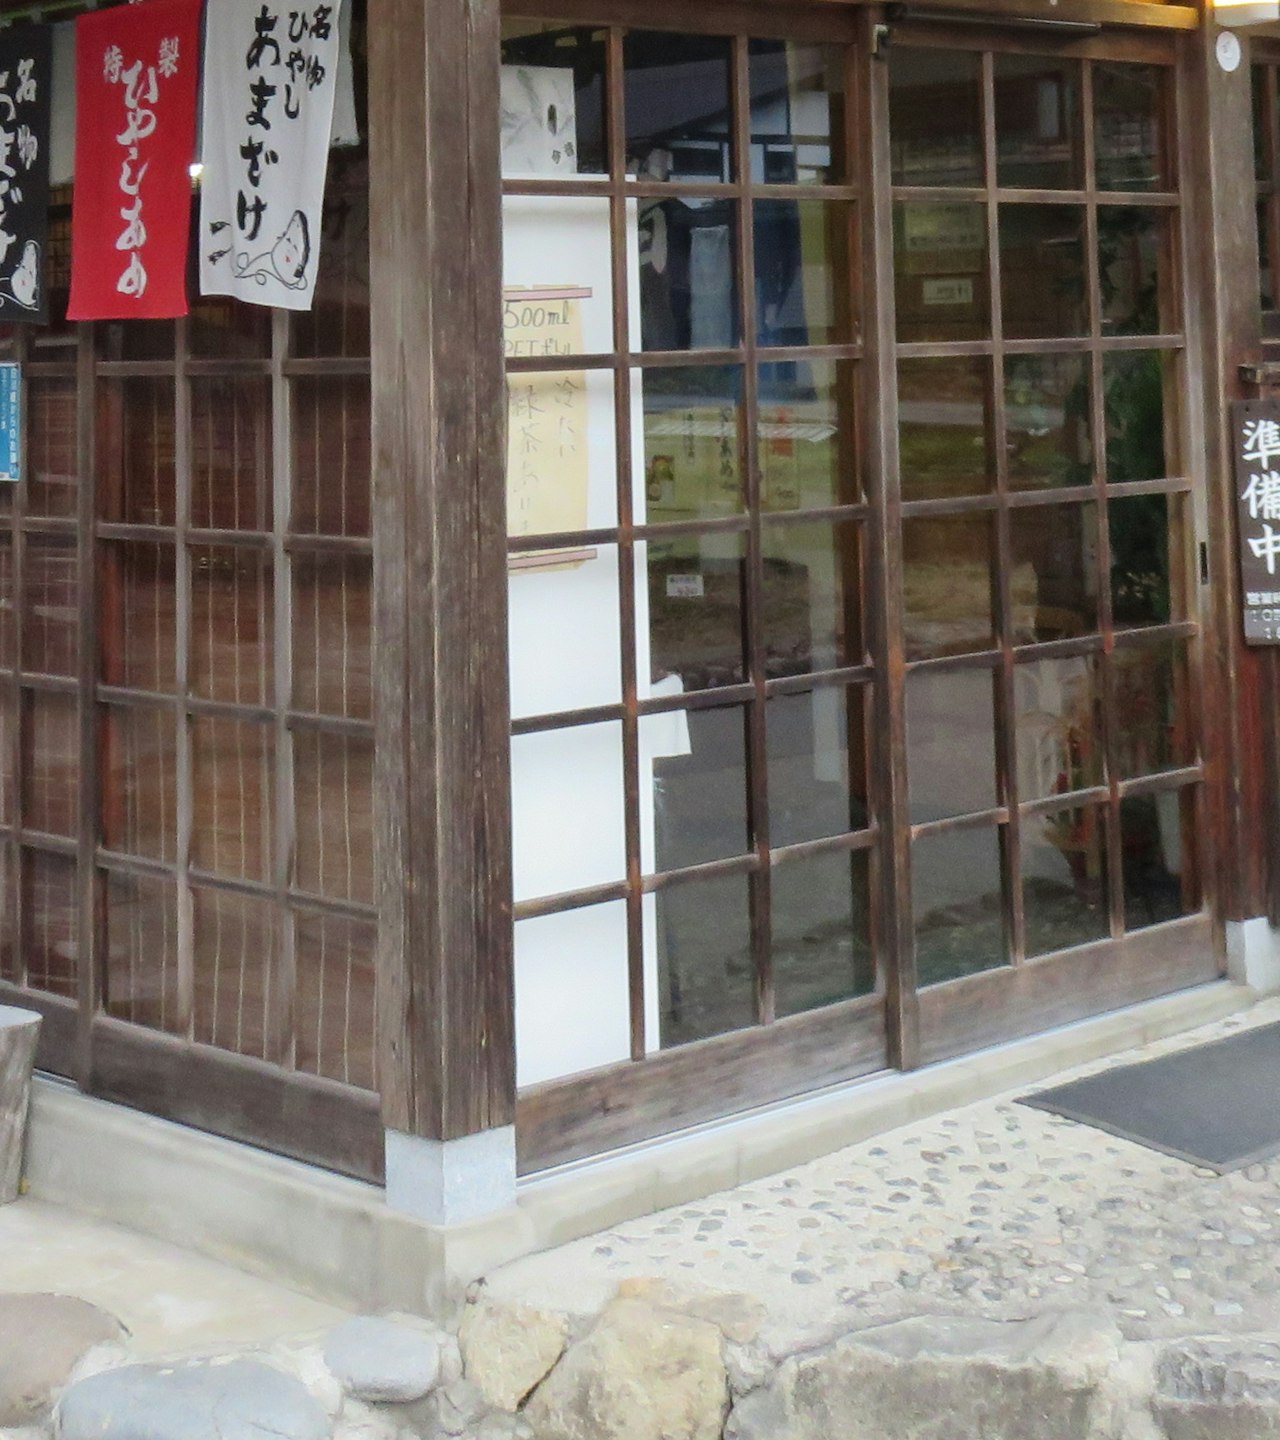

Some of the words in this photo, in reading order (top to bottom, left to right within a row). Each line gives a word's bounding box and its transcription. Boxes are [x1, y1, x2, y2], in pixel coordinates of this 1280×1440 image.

[284, 10, 309, 120] ひやし
[307, 4, 332, 92] 名物
[237, 5, 279, 241] あまざけ
[115, 59, 158, 299] ひやしあめ
[504, 300, 570, 329] 500ml
